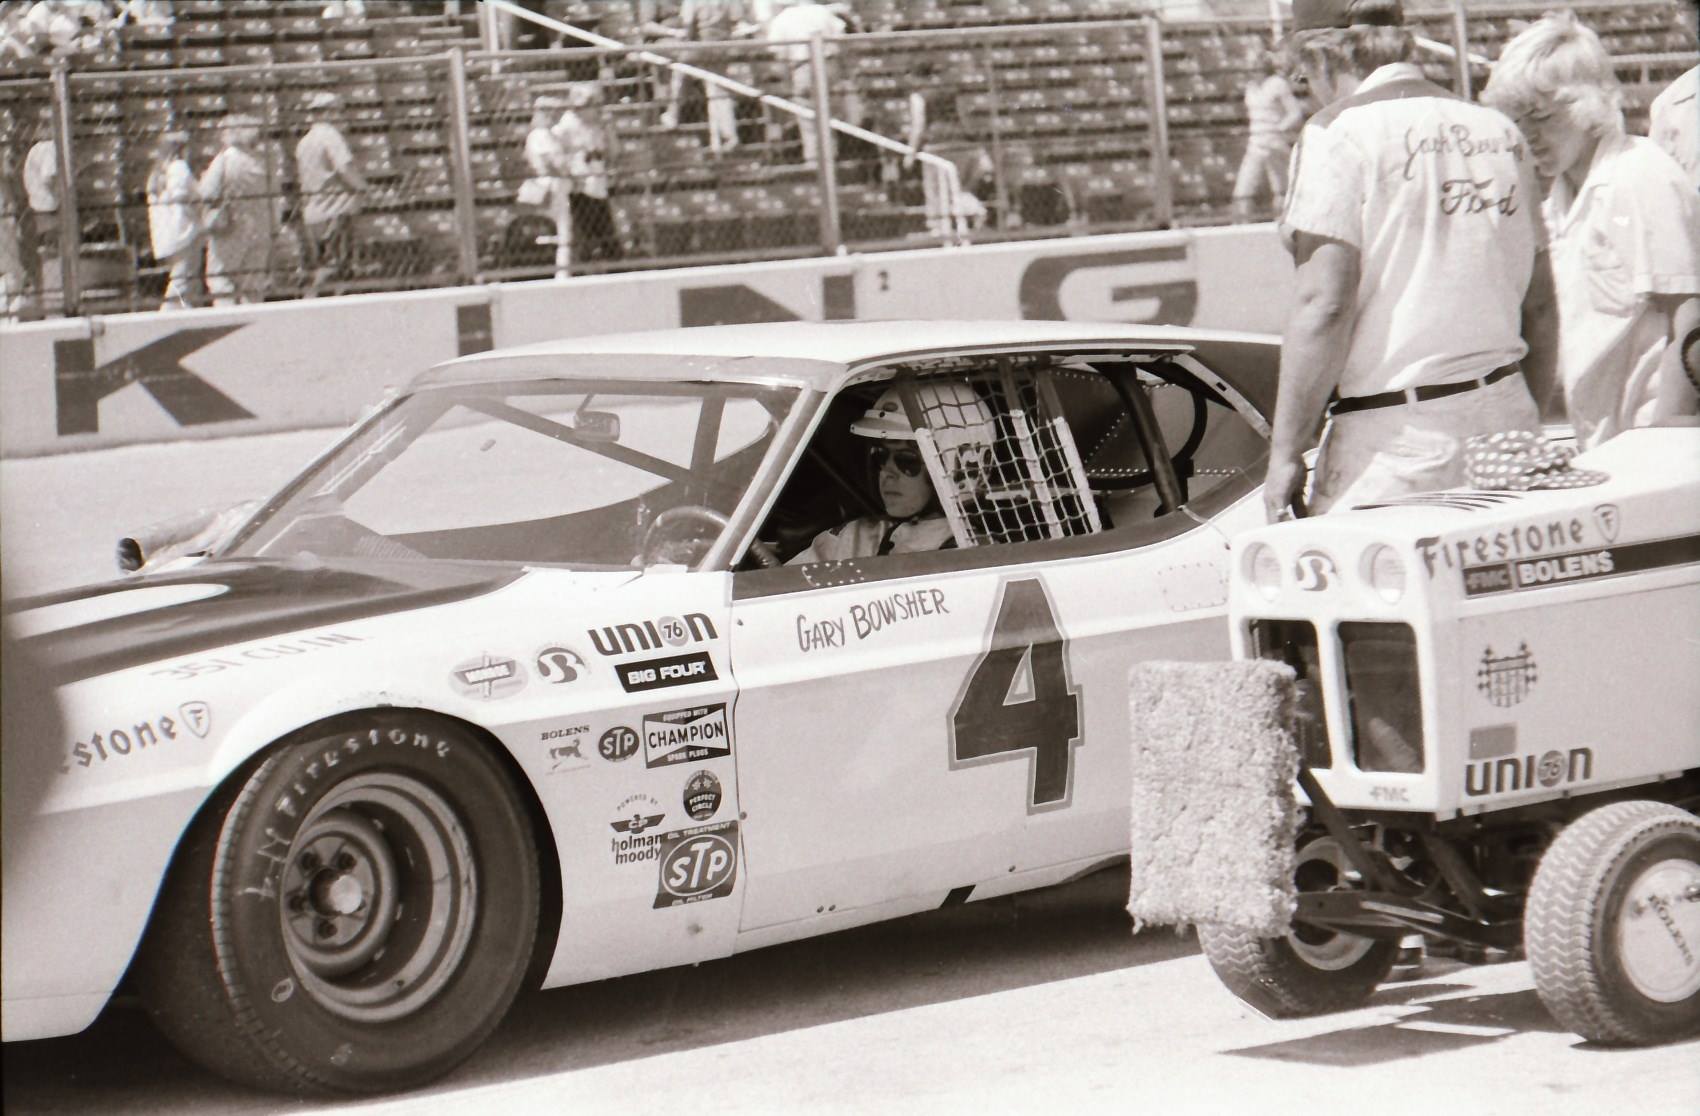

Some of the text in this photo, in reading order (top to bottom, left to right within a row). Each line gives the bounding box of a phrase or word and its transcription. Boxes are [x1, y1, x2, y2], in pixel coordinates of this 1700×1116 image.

[1440, 178, 1520, 216] Ford
[1415, 518, 1583, 579] Firestone
[1519, 551, 1614, 585] BOLENS
[664, 622, 682, 638] 76
[796, 589, 949, 652] GARY BOWSHER
[628, 661, 705, 684] BIG FOUR
[946, 572, 1085, 816] 4
[541, 725, 590, 740] BOLENS
[603, 729, 634, 755] STP
[648, 721, 723, 748] CHAMPION
[688, 748, 708, 758] PLUGS
[616, 847, 660, 864] moody
[669, 841, 728, 888] STP
